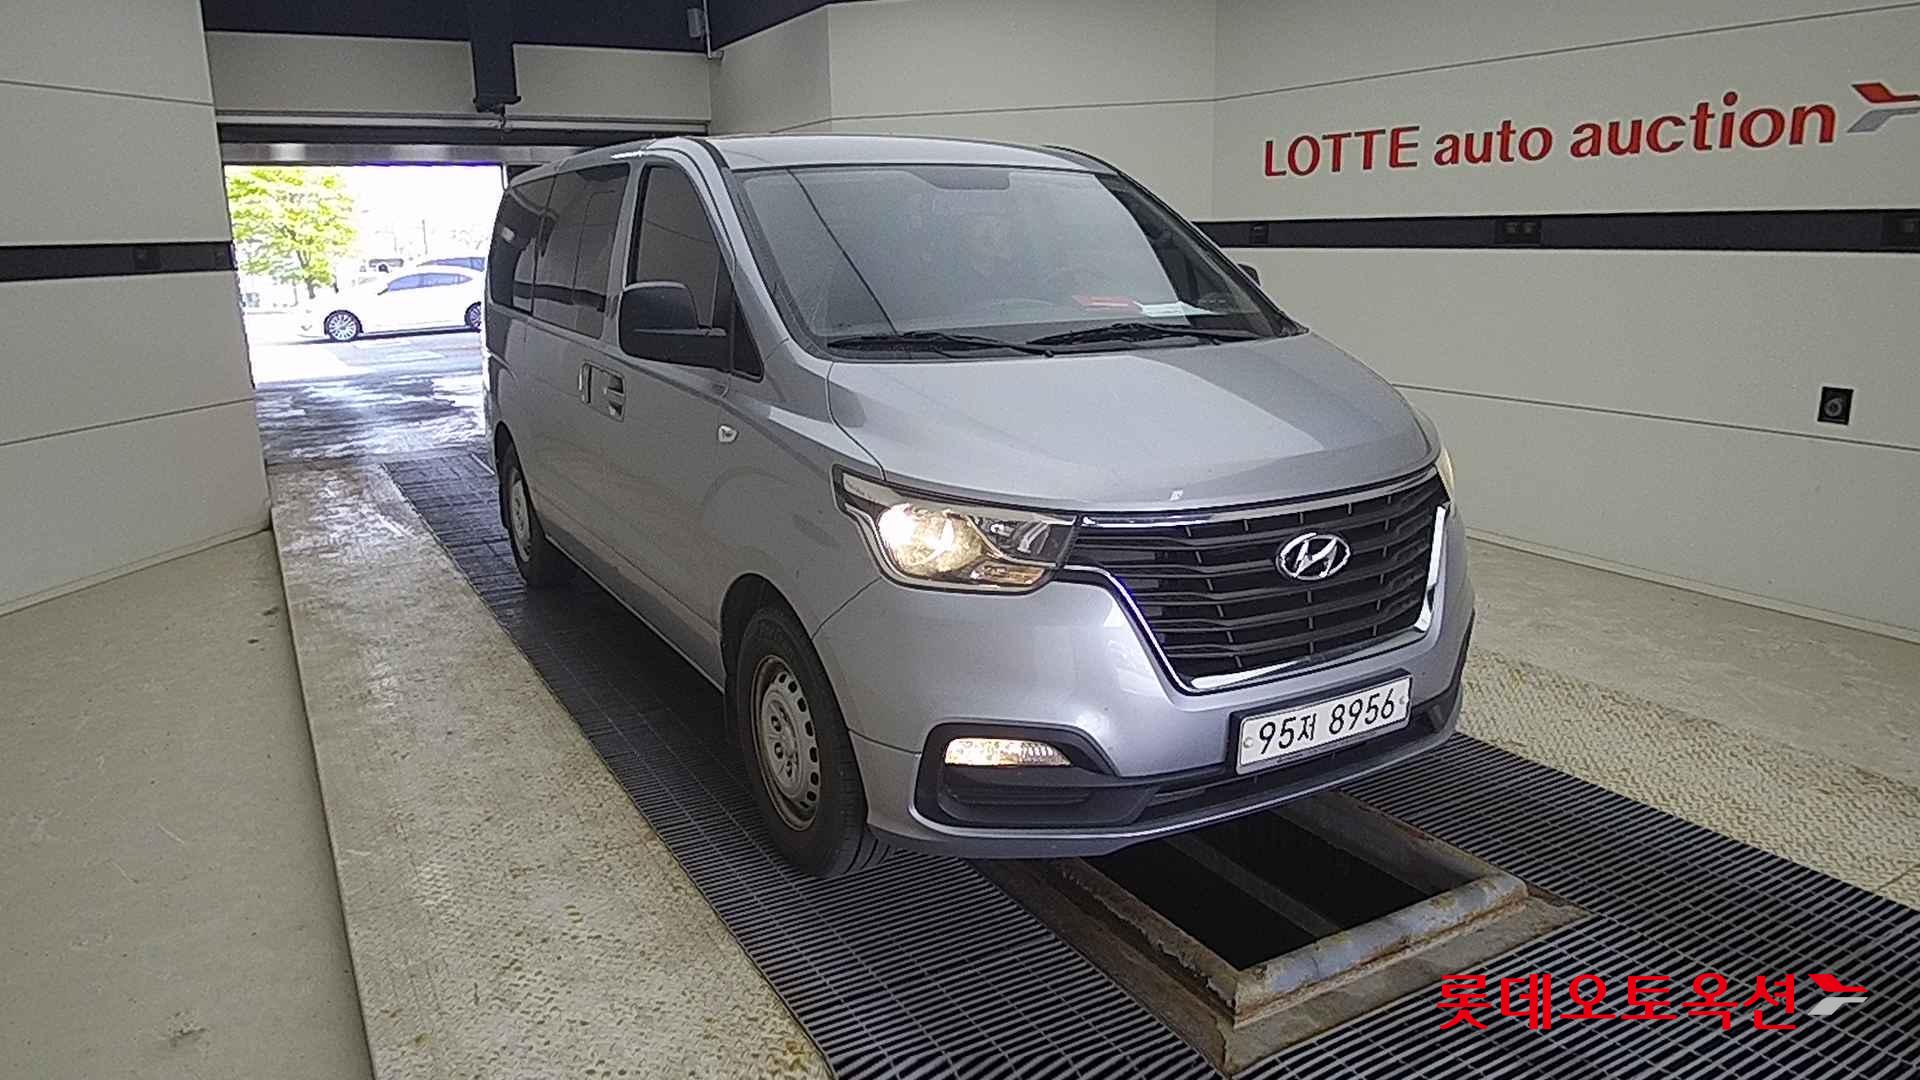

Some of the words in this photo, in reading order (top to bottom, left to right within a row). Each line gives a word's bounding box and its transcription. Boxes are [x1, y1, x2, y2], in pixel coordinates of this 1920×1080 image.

[1264, 125, 1420, 178] LOTTE
[1434, 120, 1553, 167] auto
[1570, 91, 1837, 160] auction
[1258, 714, 1318, 755] 95저
[1328, 688, 1395, 735] 8956
